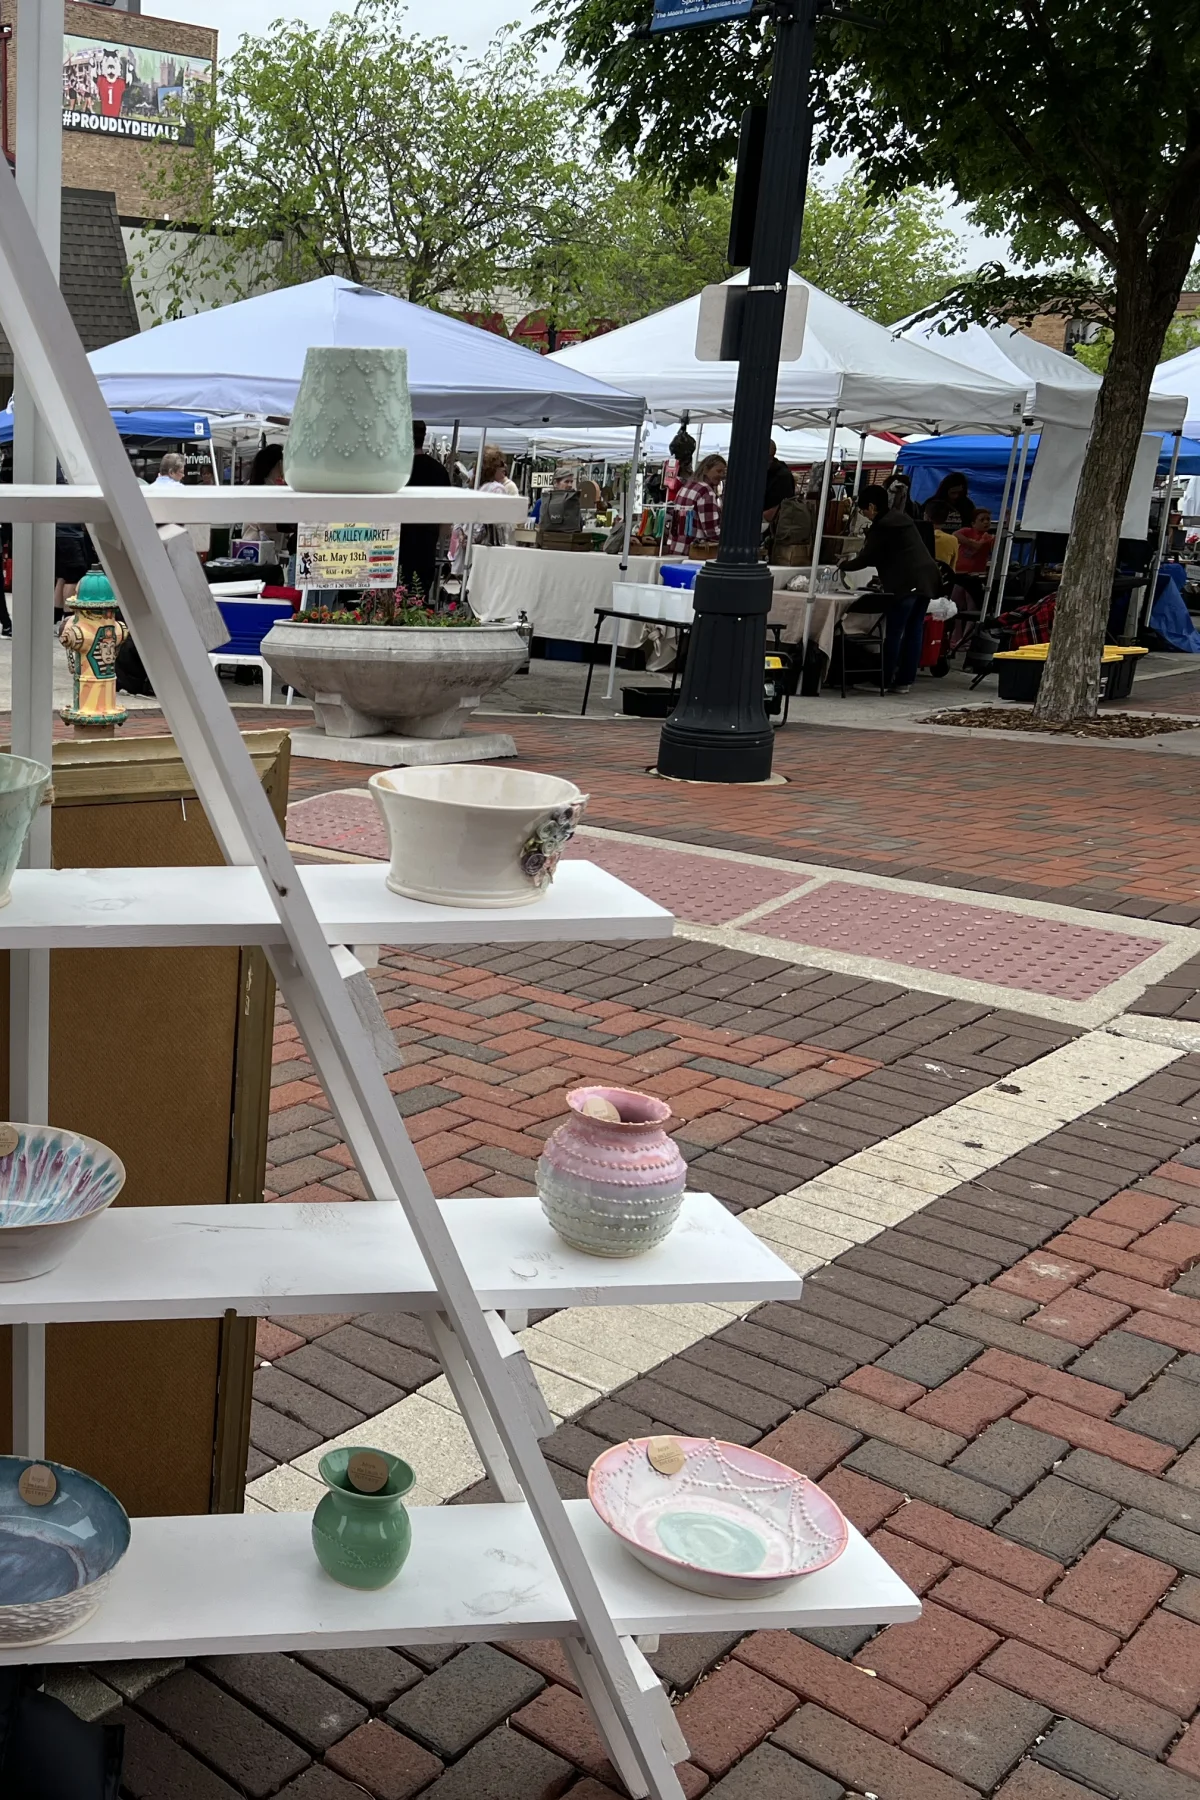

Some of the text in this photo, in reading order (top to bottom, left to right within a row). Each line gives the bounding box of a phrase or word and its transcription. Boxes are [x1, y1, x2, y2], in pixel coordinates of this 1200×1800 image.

[324, 529, 390, 542] BACK ALLEY MARKET
[312, 552, 328, 562] Sat.
[330, 552, 348, 564] May
[350, 551, 367, 561] 13th
